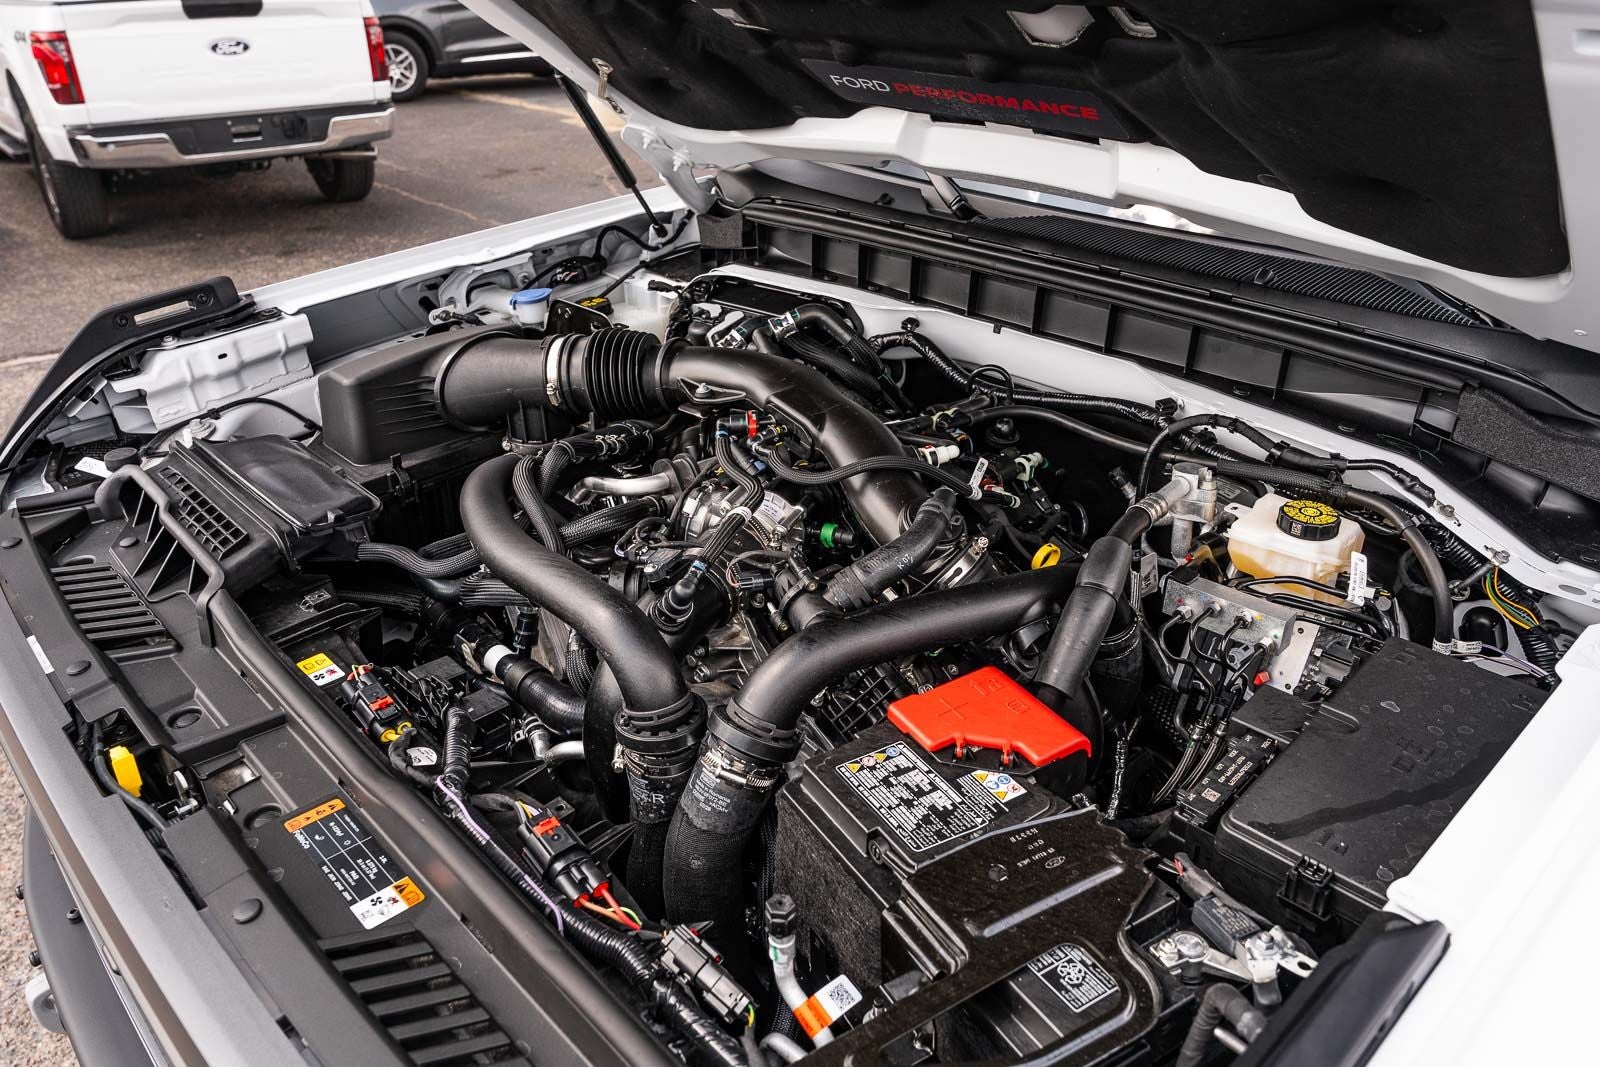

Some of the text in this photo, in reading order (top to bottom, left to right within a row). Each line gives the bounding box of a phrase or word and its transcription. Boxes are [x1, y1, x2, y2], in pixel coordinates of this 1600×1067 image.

[829, 74, 1100, 121] FORD PERFORMANCE
[652, 794, 665, 804] R
[293, 830, 310, 849] FoMoCo
